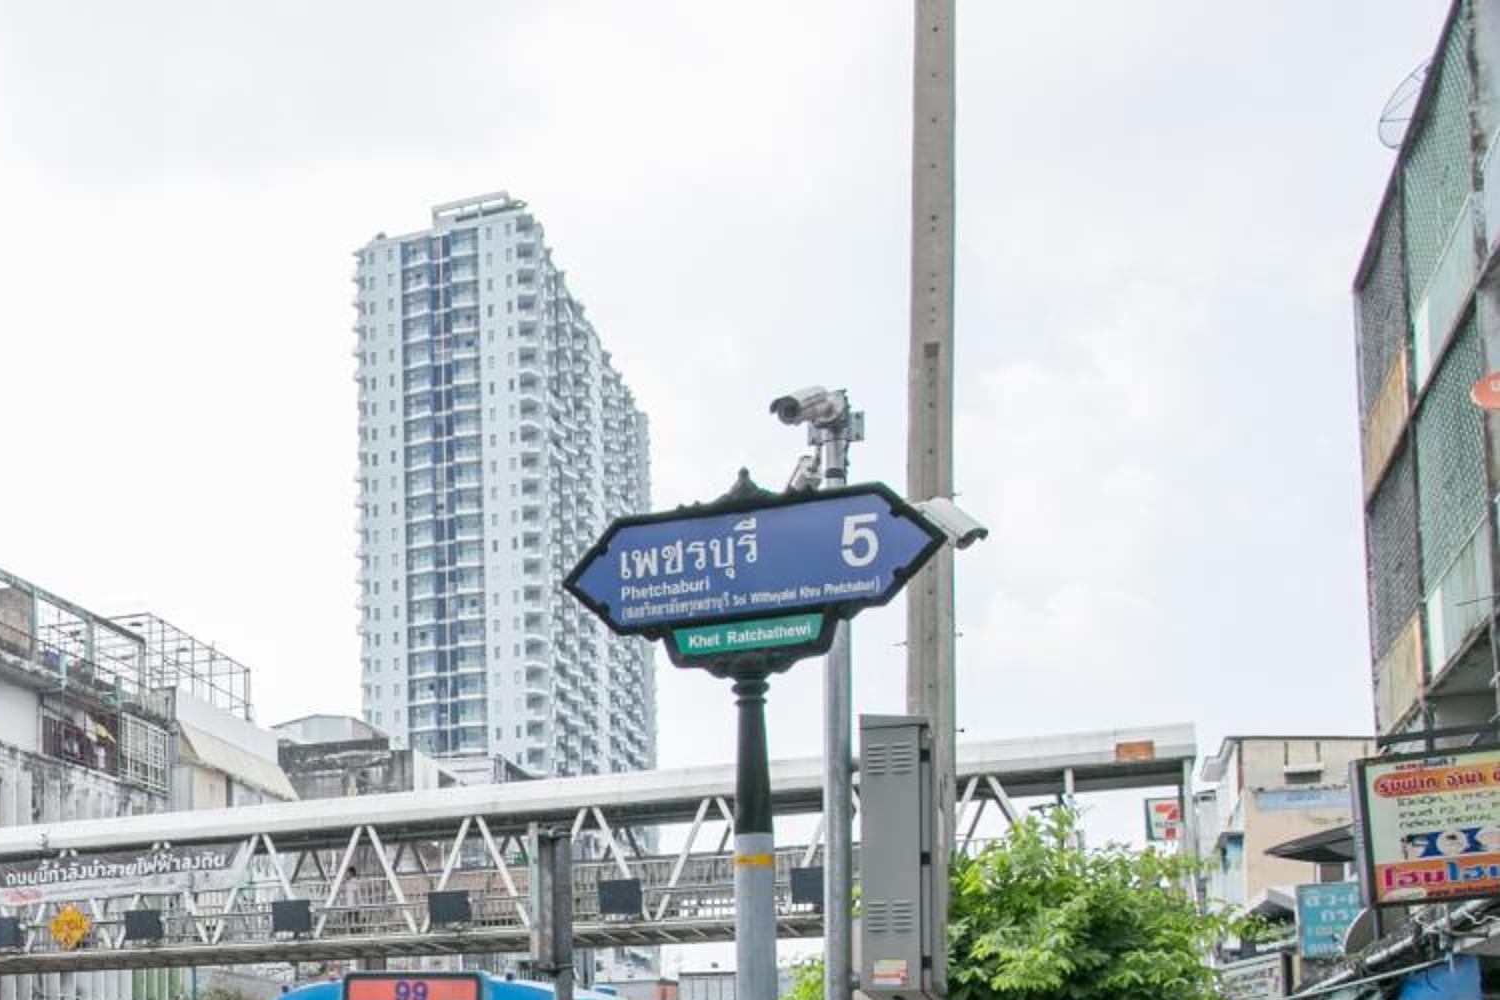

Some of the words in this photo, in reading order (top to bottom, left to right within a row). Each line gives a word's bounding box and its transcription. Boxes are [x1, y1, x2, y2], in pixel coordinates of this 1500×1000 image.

[620, 517, 757, 579] เพชรบุรี
[841, 512, 879, 567] 5
[621, 576, 710, 601] Phetchaburi
[689, 632, 720, 648] Khet
[727, 622, 811, 645] Ratchathewi
